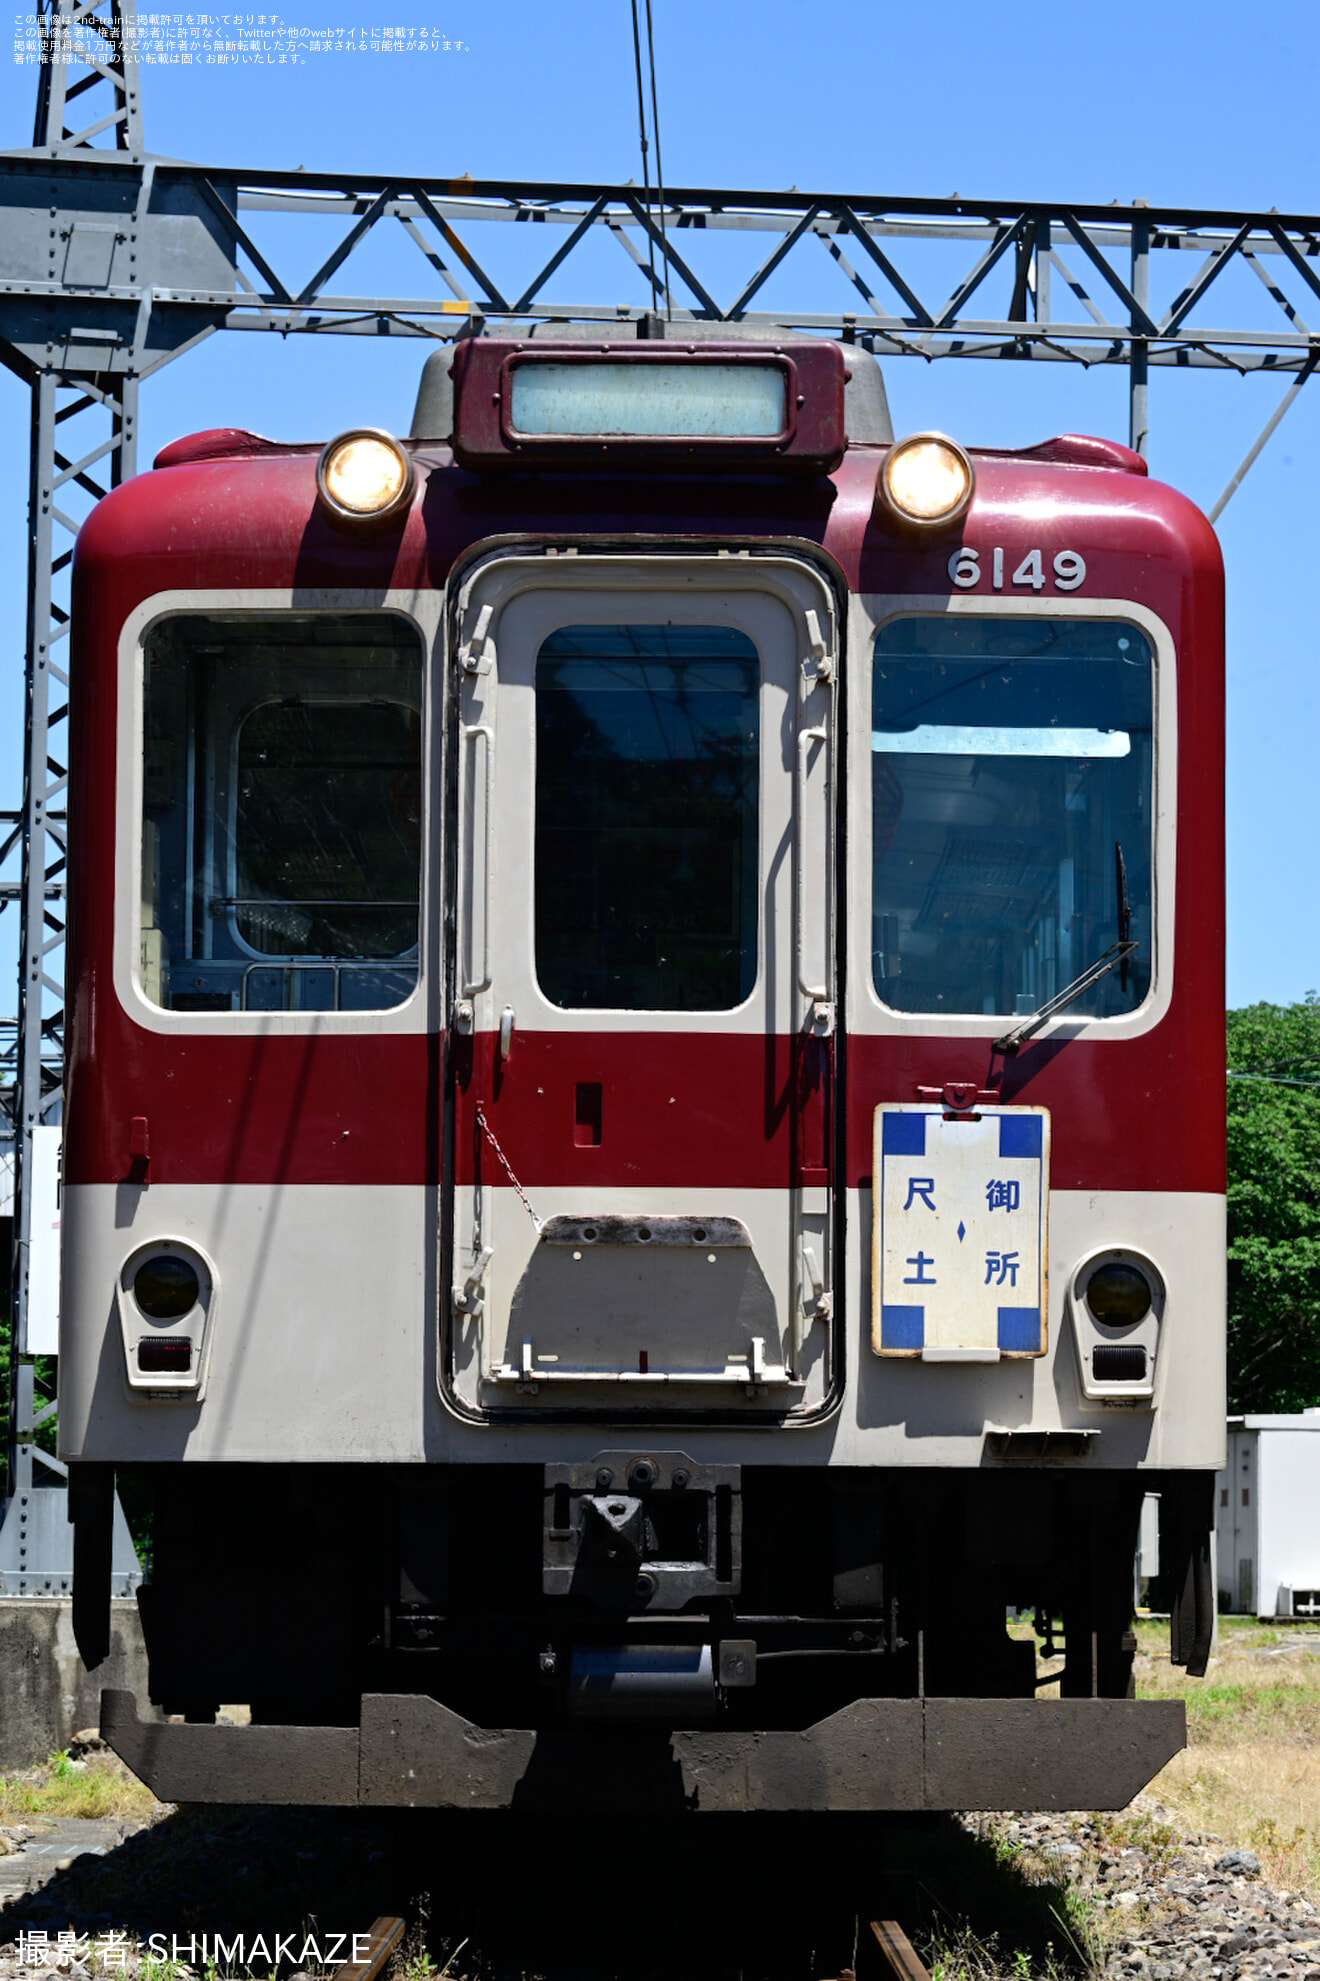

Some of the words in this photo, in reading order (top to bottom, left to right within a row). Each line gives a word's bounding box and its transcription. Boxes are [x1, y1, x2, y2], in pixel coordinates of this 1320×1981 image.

[947, 547, 1087, 591] 6149
[903, 1177, 937, 1285] 尺土
[984, 1178, 1020, 1287] 御所
